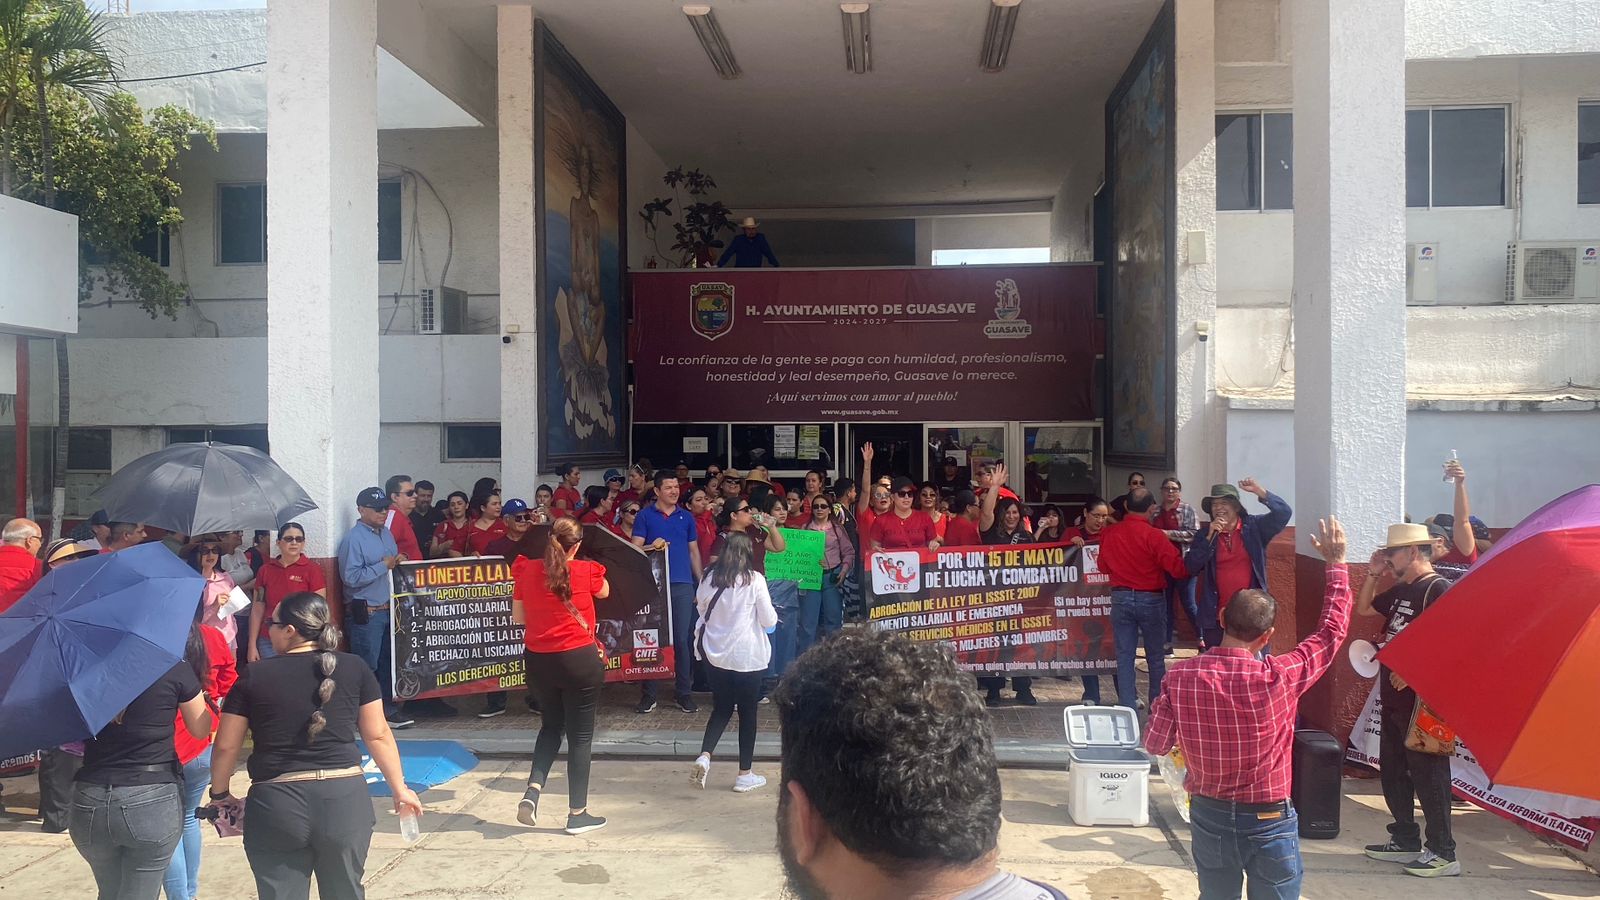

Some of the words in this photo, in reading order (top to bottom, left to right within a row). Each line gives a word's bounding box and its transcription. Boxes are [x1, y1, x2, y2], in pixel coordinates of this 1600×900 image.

[746, 305, 760, 316] H.
[764, 304, 879, 316] AYUNTAMIENTO
[883, 304, 902, 315] DE
[906, 303, 976, 315] GUASAVE
[985, 326, 1031, 334] GUASAVE
[660, 355, 674, 365] La
[677, 354, 739, 365] confianza
[742, 354, 758, 365] de
[760, 354, 772, 365] la
[775, 356, 811, 367] gente
[814, 356, 828, 364] se
[831, 356, 864, 367] paga
[867, 356, 890, 364] con
[894, 353, 958, 366] humildad,
[961, 352, 1067, 366] profesionalismo,
[706, 371, 776, 381] honestidad
[778, 373, 786, 383] y
[789, 371, 811, 381] leal
[815, 371, 890, 383] desempeño,
[894, 371, 949, 381] Guasave
[952, 370, 964, 380] lo
[967, 372, 1017, 380] merece.
[766, 392, 799, 403] ¡Aquí
[800, 392, 847, 402] servimos
[850, 393, 869, 401] con
[872, 393, 901, 401] amor
[904, 392, 914, 401] al
[915, 391, 959, 403] pueblo!
[820, 408, 899, 416] www.guasave.gob.mx
[938, 552, 963, 569] POR
[966, 552, 985, 568] UN
[987, 551, 1001, 567] 15
[1005, 550, 1021, 566] DE
[1023, 548, 1064, 566] MAYO
[427, 565, 472, 585] ÚNETE
[474, 564, 484, 582] A
[487, 563, 501, 581] LA
[925, 572, 942, 588] DE
[944, 570, 987, 588] LUCHA
[989, 569, 999, 586] Y
[1002, 566, 1078, 586] COMBATIVO
[437, 587, 465, 600] APOYO
[466, 586, 492, 598] TOTAL
[495, 585, 504, 596] AL
[884, 583, 909, 591] CNTE
[424, 603, 467, 616] AUMENTO
[468, 600, 511, 614] SALARIAL
[870, 599, 922, 619] ABROGACIÓN
[923, 598, 935, 610] DE
[936, 597, 948, 609] LA
[950, 595, 966, 608] LEY
[968, 592, 984, 605] DEL
[986, 587, 1015, 603] ISSSTE
[1017, 586, 1040, 599] 2007
[1065, 597, 1075, 606] no
[1076, 595, 1091, 606] hay
[911, 611, 954, 627] SALARIAL
[956, 610, 968, 621] DE
[968, 603, 1024, 619] EMERGENCIA
[1056, 608, 1066, 617] no
[1067, 607, 1090, 617] rueda
[1092, 607, 1102, 616] su
[425, 617, 481, 631] ABROGACIÓN
[483, 616, 494, 627] DE
[496, 615, 508, 626] LA
[909, 626, 954, 641] SERVICIOS
[956, 622, 994, 636] MÉDICOS
[996, 620, 1008, 632] EN
[1009, 619, 1019, 630] EL
[1021, 615, 1052, 629] ISSSTE
[425, 631, 482, 647] ABROGACIÓN
[484, 631, 496, 643] DE
[497, 630, 508, 641] LA
[510, 629, 526, 640] LEY
[959, 636, 1000, 651] MUJERES
[1003, 634, 1010, 646] Y
[1011, 633, 1023, 646] 30
[1024, 629, 1068, 644] HOMBRES
[429, 649, 470, 661] RECHAZO
[472, 648, 483, 658] AL
[484, 644, 526, 658] USICAMM
[635, 648, 658, 658] CNTE
[459, 663, 507, 682] DERECHOS
[509, 660, 520, 673] SE
[985, 661, 1004, 672] quien
[1038, 660, 1049, 670] los
[1050, 660, 1084, 670] derechos
[1086, 660, 1095, 668] se
[1451, 777, 1485, 799] FEDERAL
[1487, 794, 1507, 807] ESTA
[1507, 803, 1549, 825] REFORMA
[1548, 818, 1557, 828] TE
[1556, 822, 1592, 841] AFECTA
